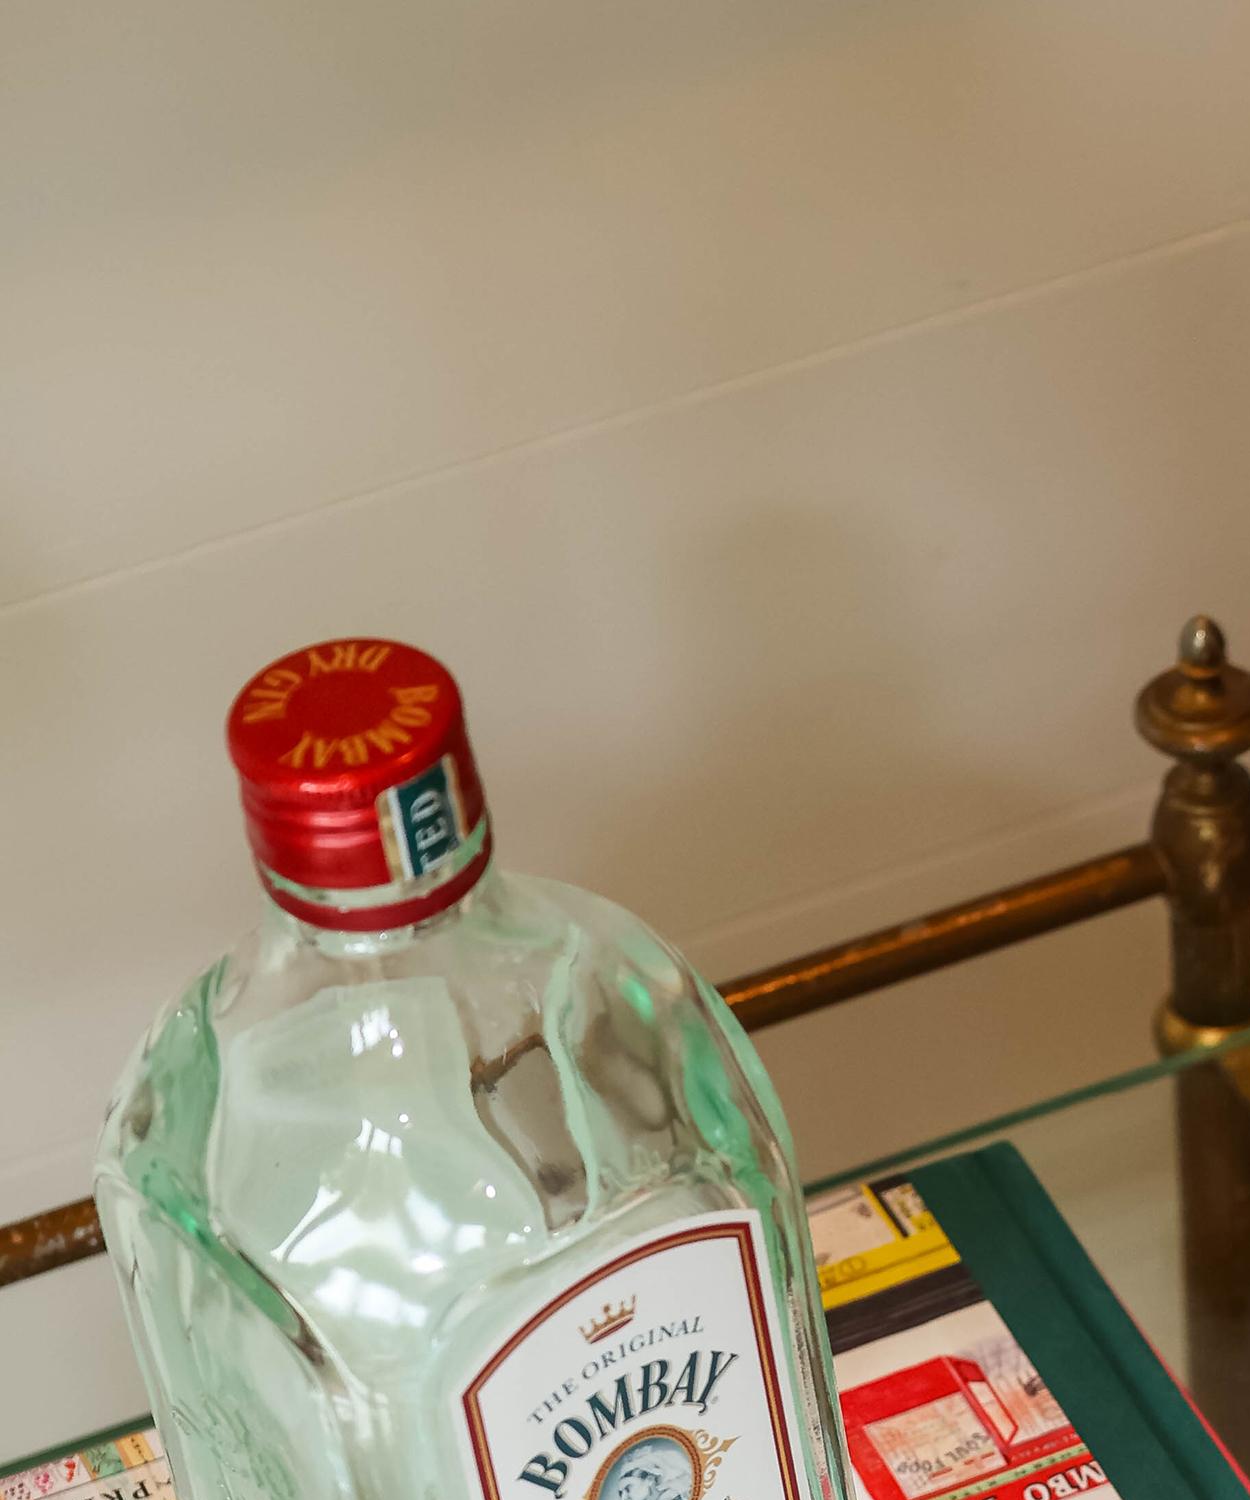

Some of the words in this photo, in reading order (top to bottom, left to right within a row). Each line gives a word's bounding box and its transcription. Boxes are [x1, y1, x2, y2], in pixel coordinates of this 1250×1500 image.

[242, 669, 302, 724] GIN
[305, 645, 393, 677] DRY
[277, 684, 439, 768] BOMBAY
[527, 1377, 578, 1423] THE
[582, 1315, 705, 1380] ORIGINAL
[516, 1349, 739, 1500] BOMBAY
